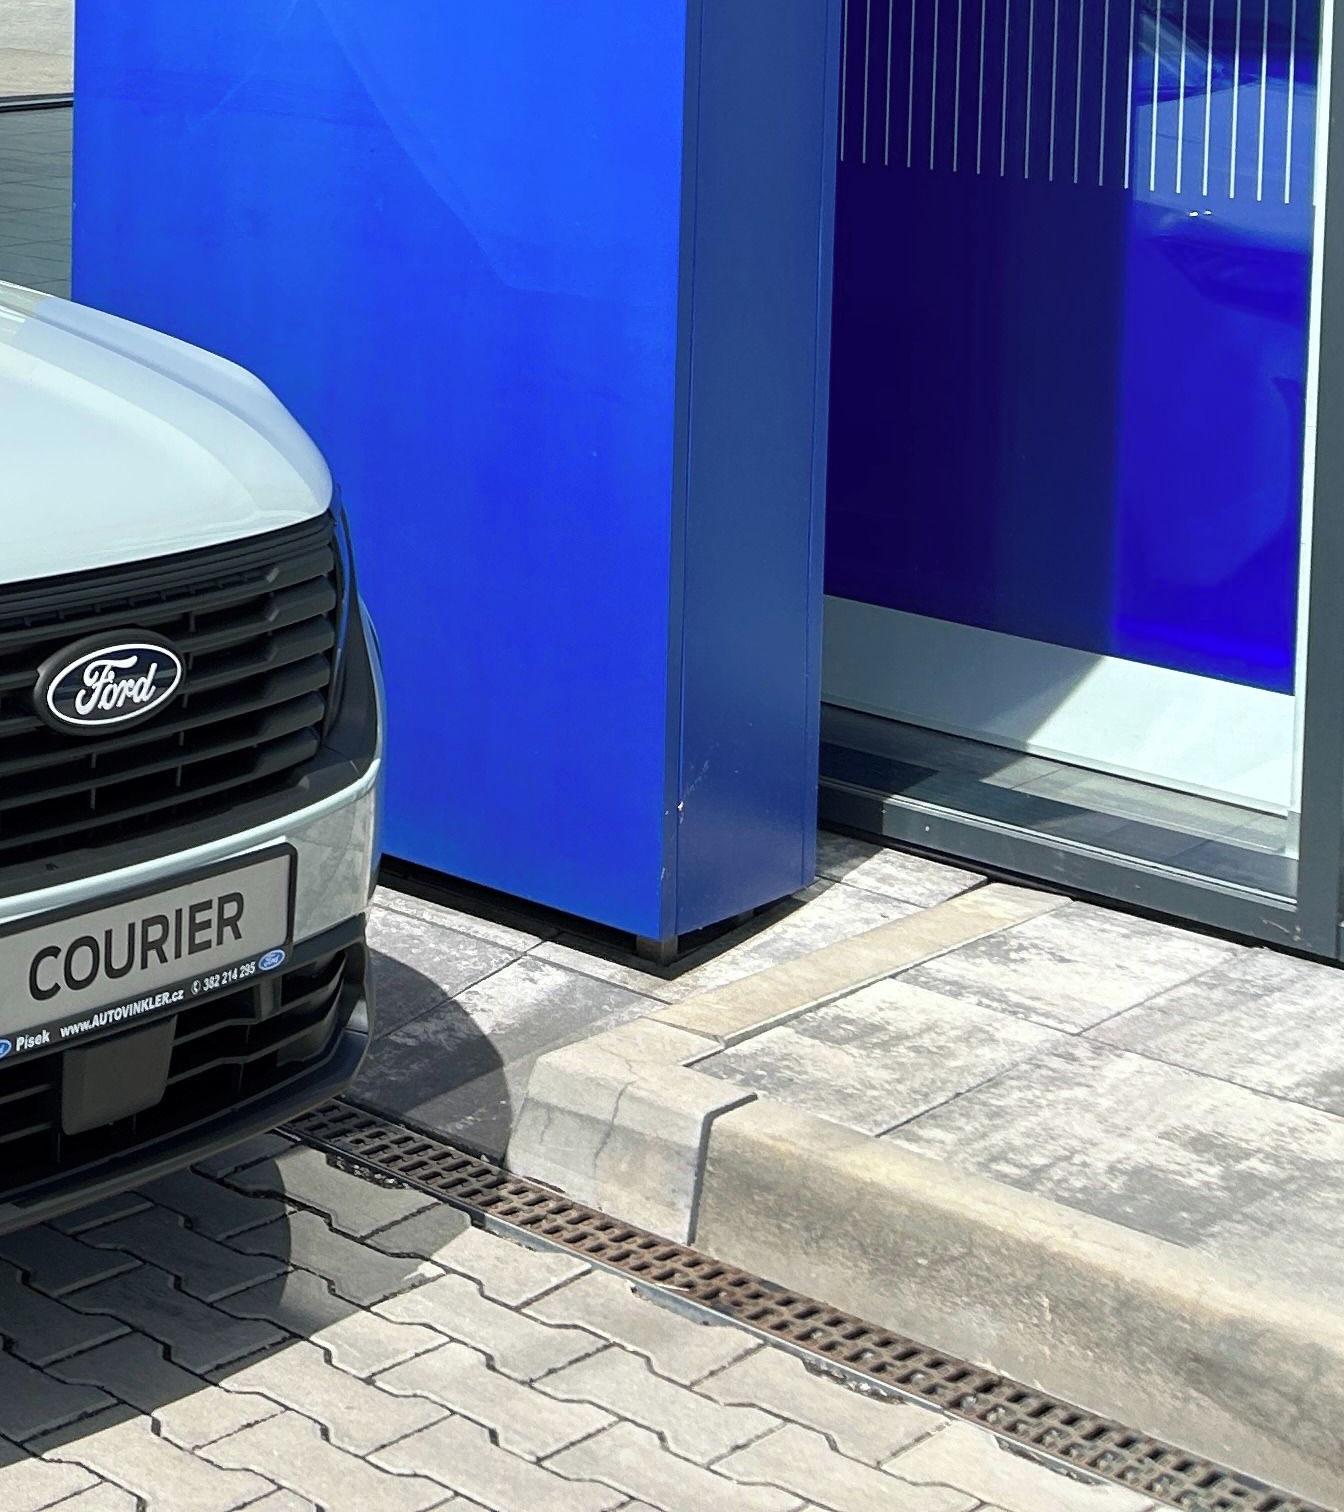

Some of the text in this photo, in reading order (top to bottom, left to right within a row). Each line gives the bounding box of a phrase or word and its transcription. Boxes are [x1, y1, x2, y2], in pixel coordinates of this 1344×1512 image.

[74, 654, 158, 716] Ford
[28, 891, 245, 1002] COURIER
[15, 1029, 51, 1052] Písek
[59, 988, 184, 1038] www.AUTOVINKLER.cz
[202, 974, 220, 991] 382
[221, 967, 238, 985] 214
